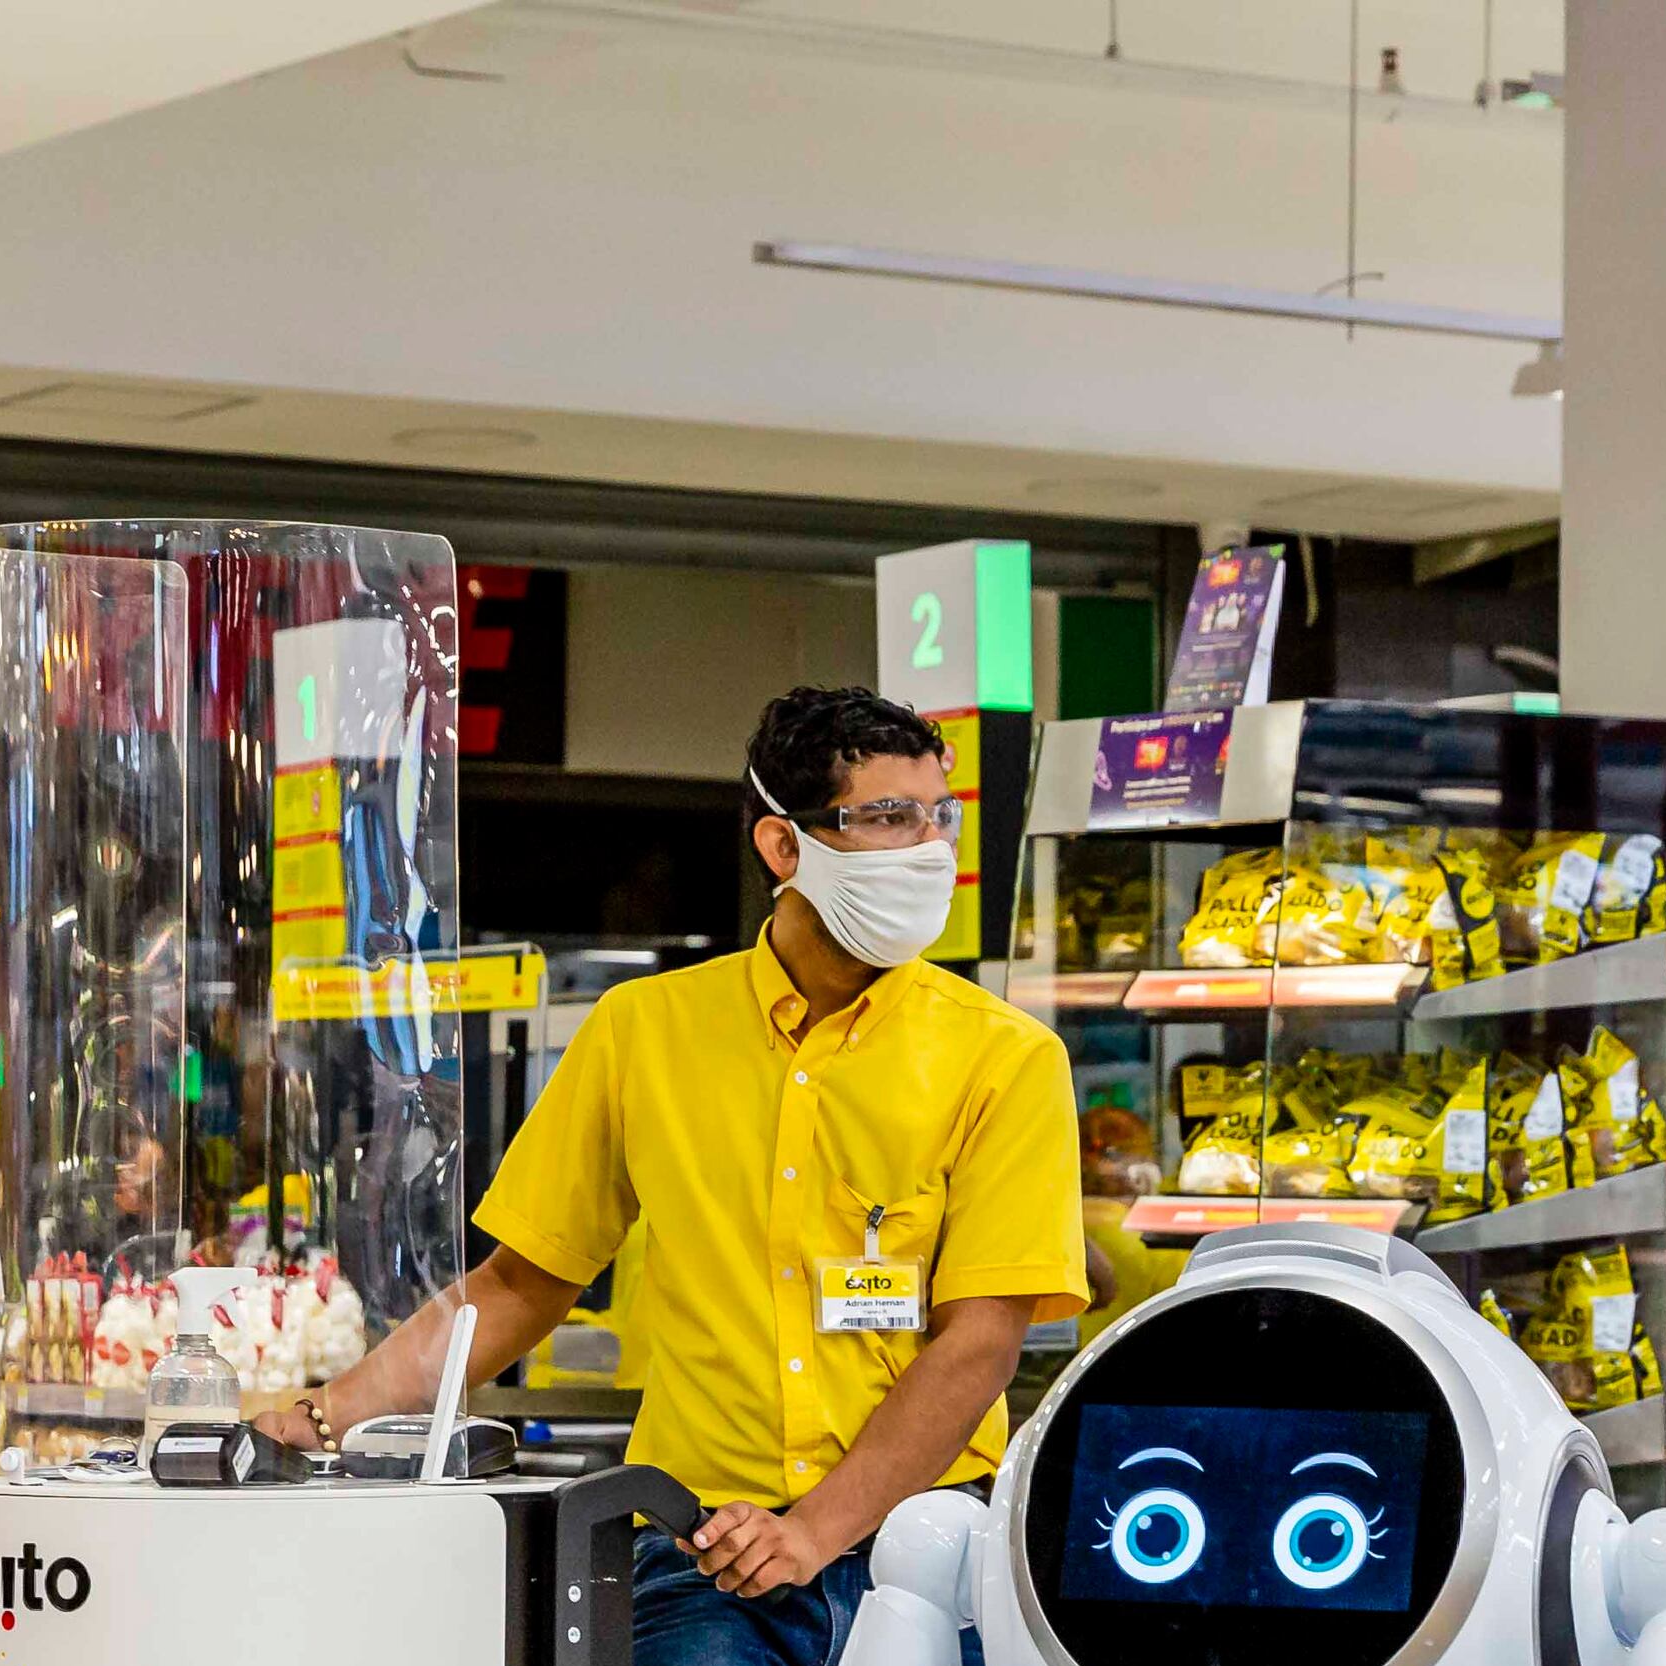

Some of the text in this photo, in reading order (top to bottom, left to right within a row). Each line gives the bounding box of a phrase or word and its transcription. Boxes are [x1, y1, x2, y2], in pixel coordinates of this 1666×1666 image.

[911, 592, 944, 669] 2
[297, 674, 317, 742] 1
[845, 1275, 892, 1293] éxito
